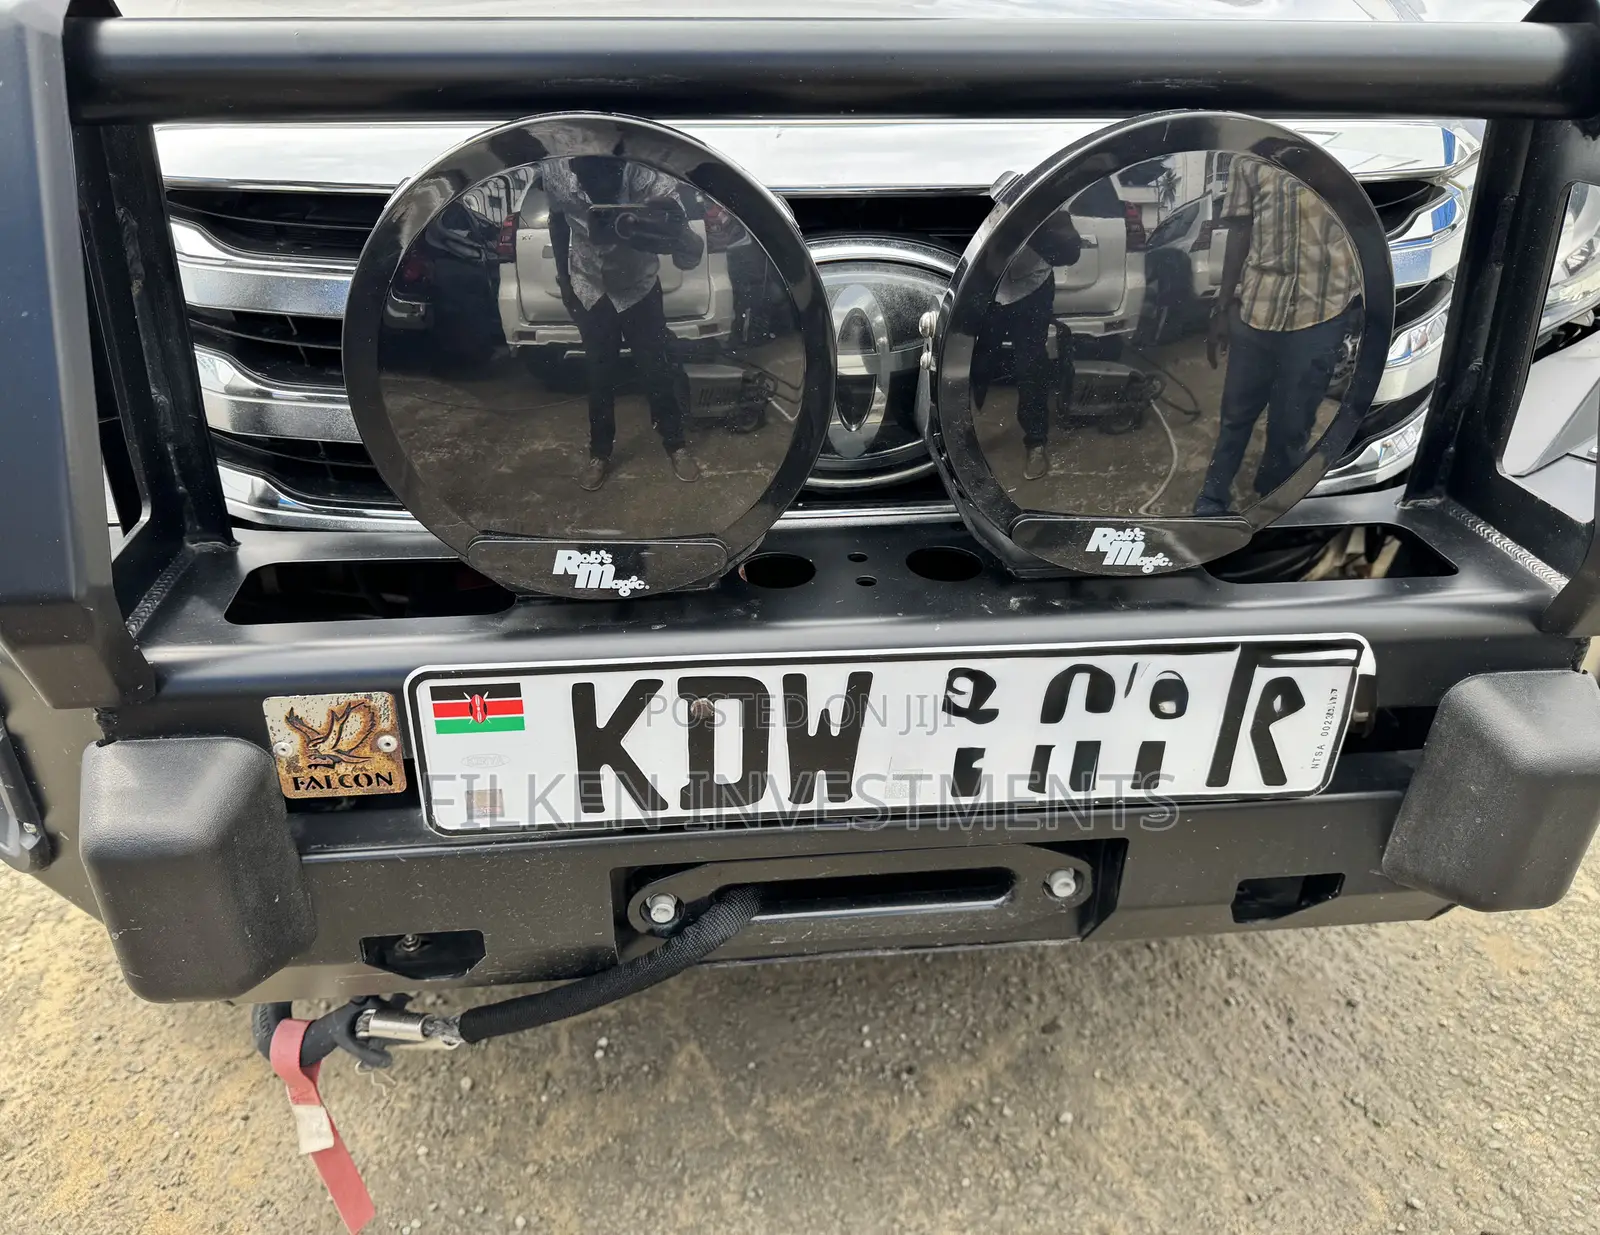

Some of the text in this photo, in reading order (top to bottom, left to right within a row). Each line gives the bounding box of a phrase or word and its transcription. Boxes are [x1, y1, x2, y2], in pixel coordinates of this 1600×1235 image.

[552, 549, 613, 575] Rob's
[571, 670, 874, 814] KDW
[292, 771, 394, 791] FALCON
